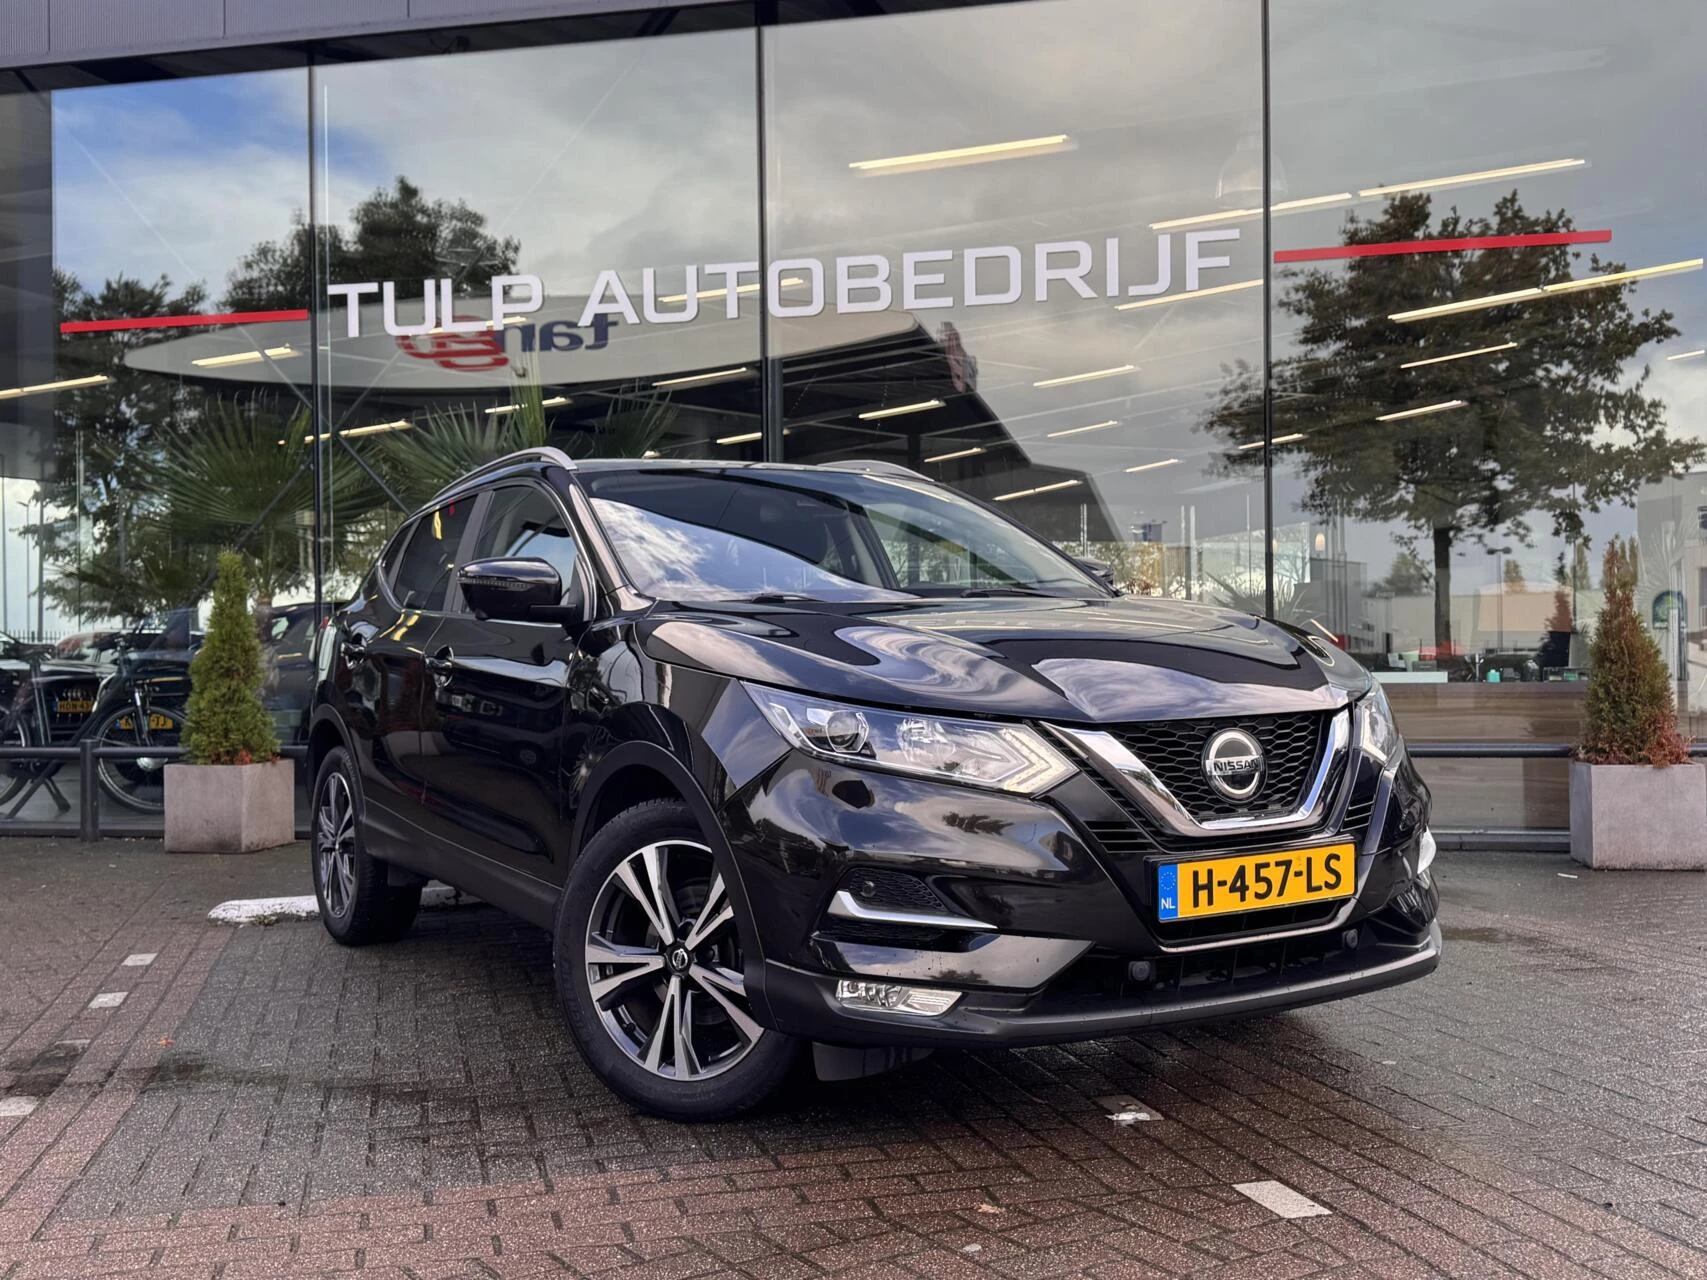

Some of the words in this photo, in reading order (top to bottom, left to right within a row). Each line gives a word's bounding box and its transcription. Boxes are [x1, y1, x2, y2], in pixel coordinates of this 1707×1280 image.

[327, 274, 544, 338] TULP
[577, 228, 1241, 327] AUTOBEDRIJF
[1213, 758, 1260, 773] NISSAN
[1161, 897, 1176, 910] NL
[1192, 853, 1342, 908] H-457-LS
